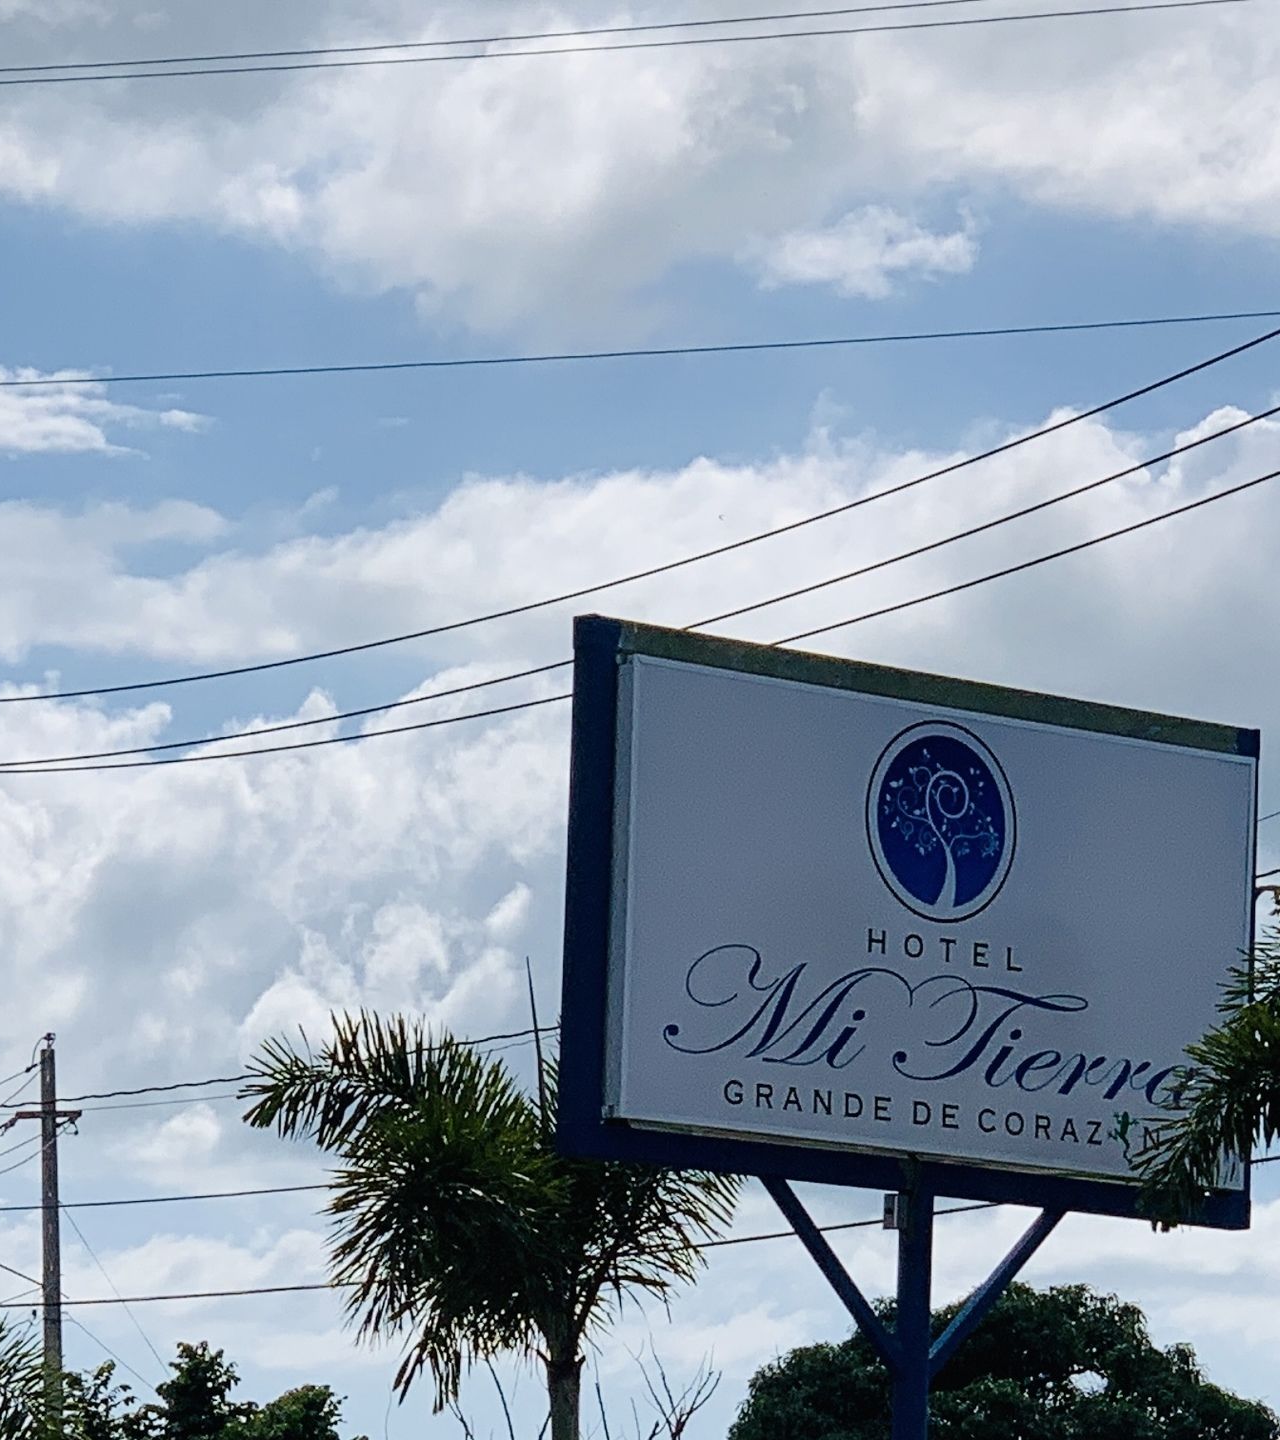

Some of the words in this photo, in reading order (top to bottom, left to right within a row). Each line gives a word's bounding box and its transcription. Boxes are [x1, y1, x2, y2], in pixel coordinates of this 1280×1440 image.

[867, 928, 1023, 972] HOTEL
[663, 943, 912, 1069] Mi
[892, 975, 1192, 1106] Tierra
[723, 1079, 892, 1122] GRANDE
[912, 1100, 960, 1130] DE
